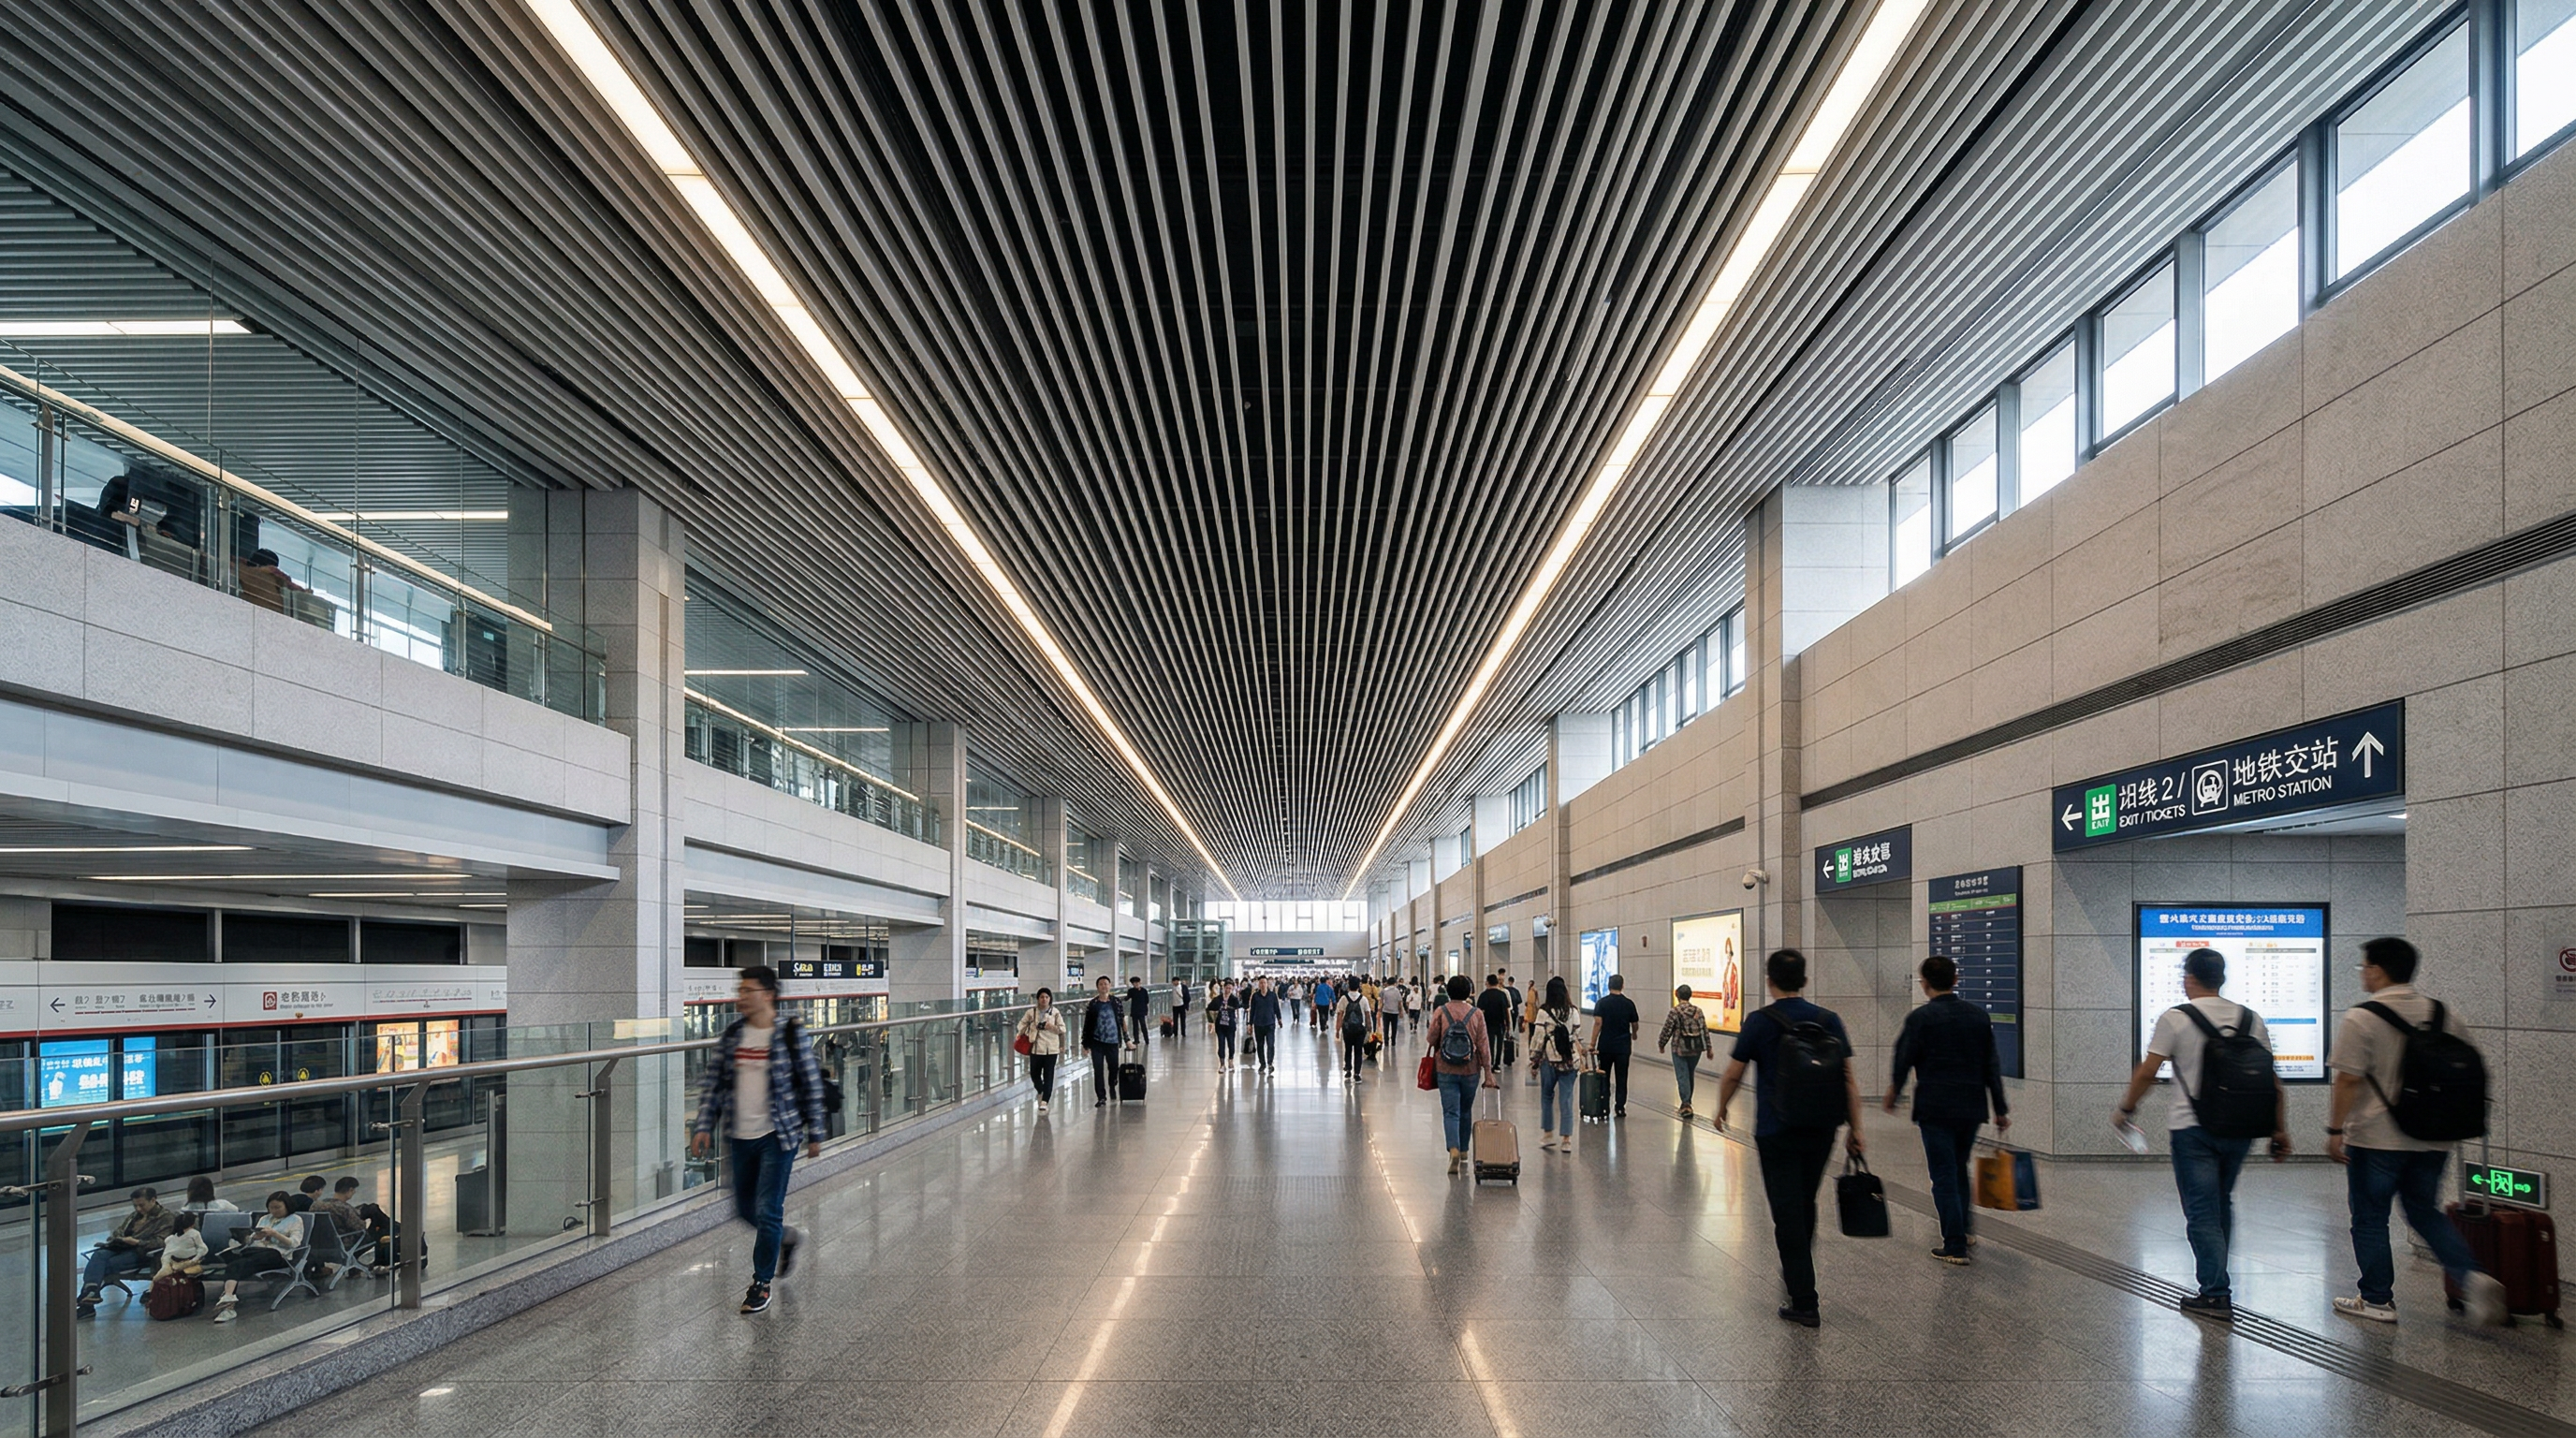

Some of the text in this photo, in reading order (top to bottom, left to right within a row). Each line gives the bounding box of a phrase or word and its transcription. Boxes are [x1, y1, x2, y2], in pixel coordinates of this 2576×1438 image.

[2232, 736, 2338, 785] 地铁交站
[2233, 774, 2332, 806] METRO STATION
